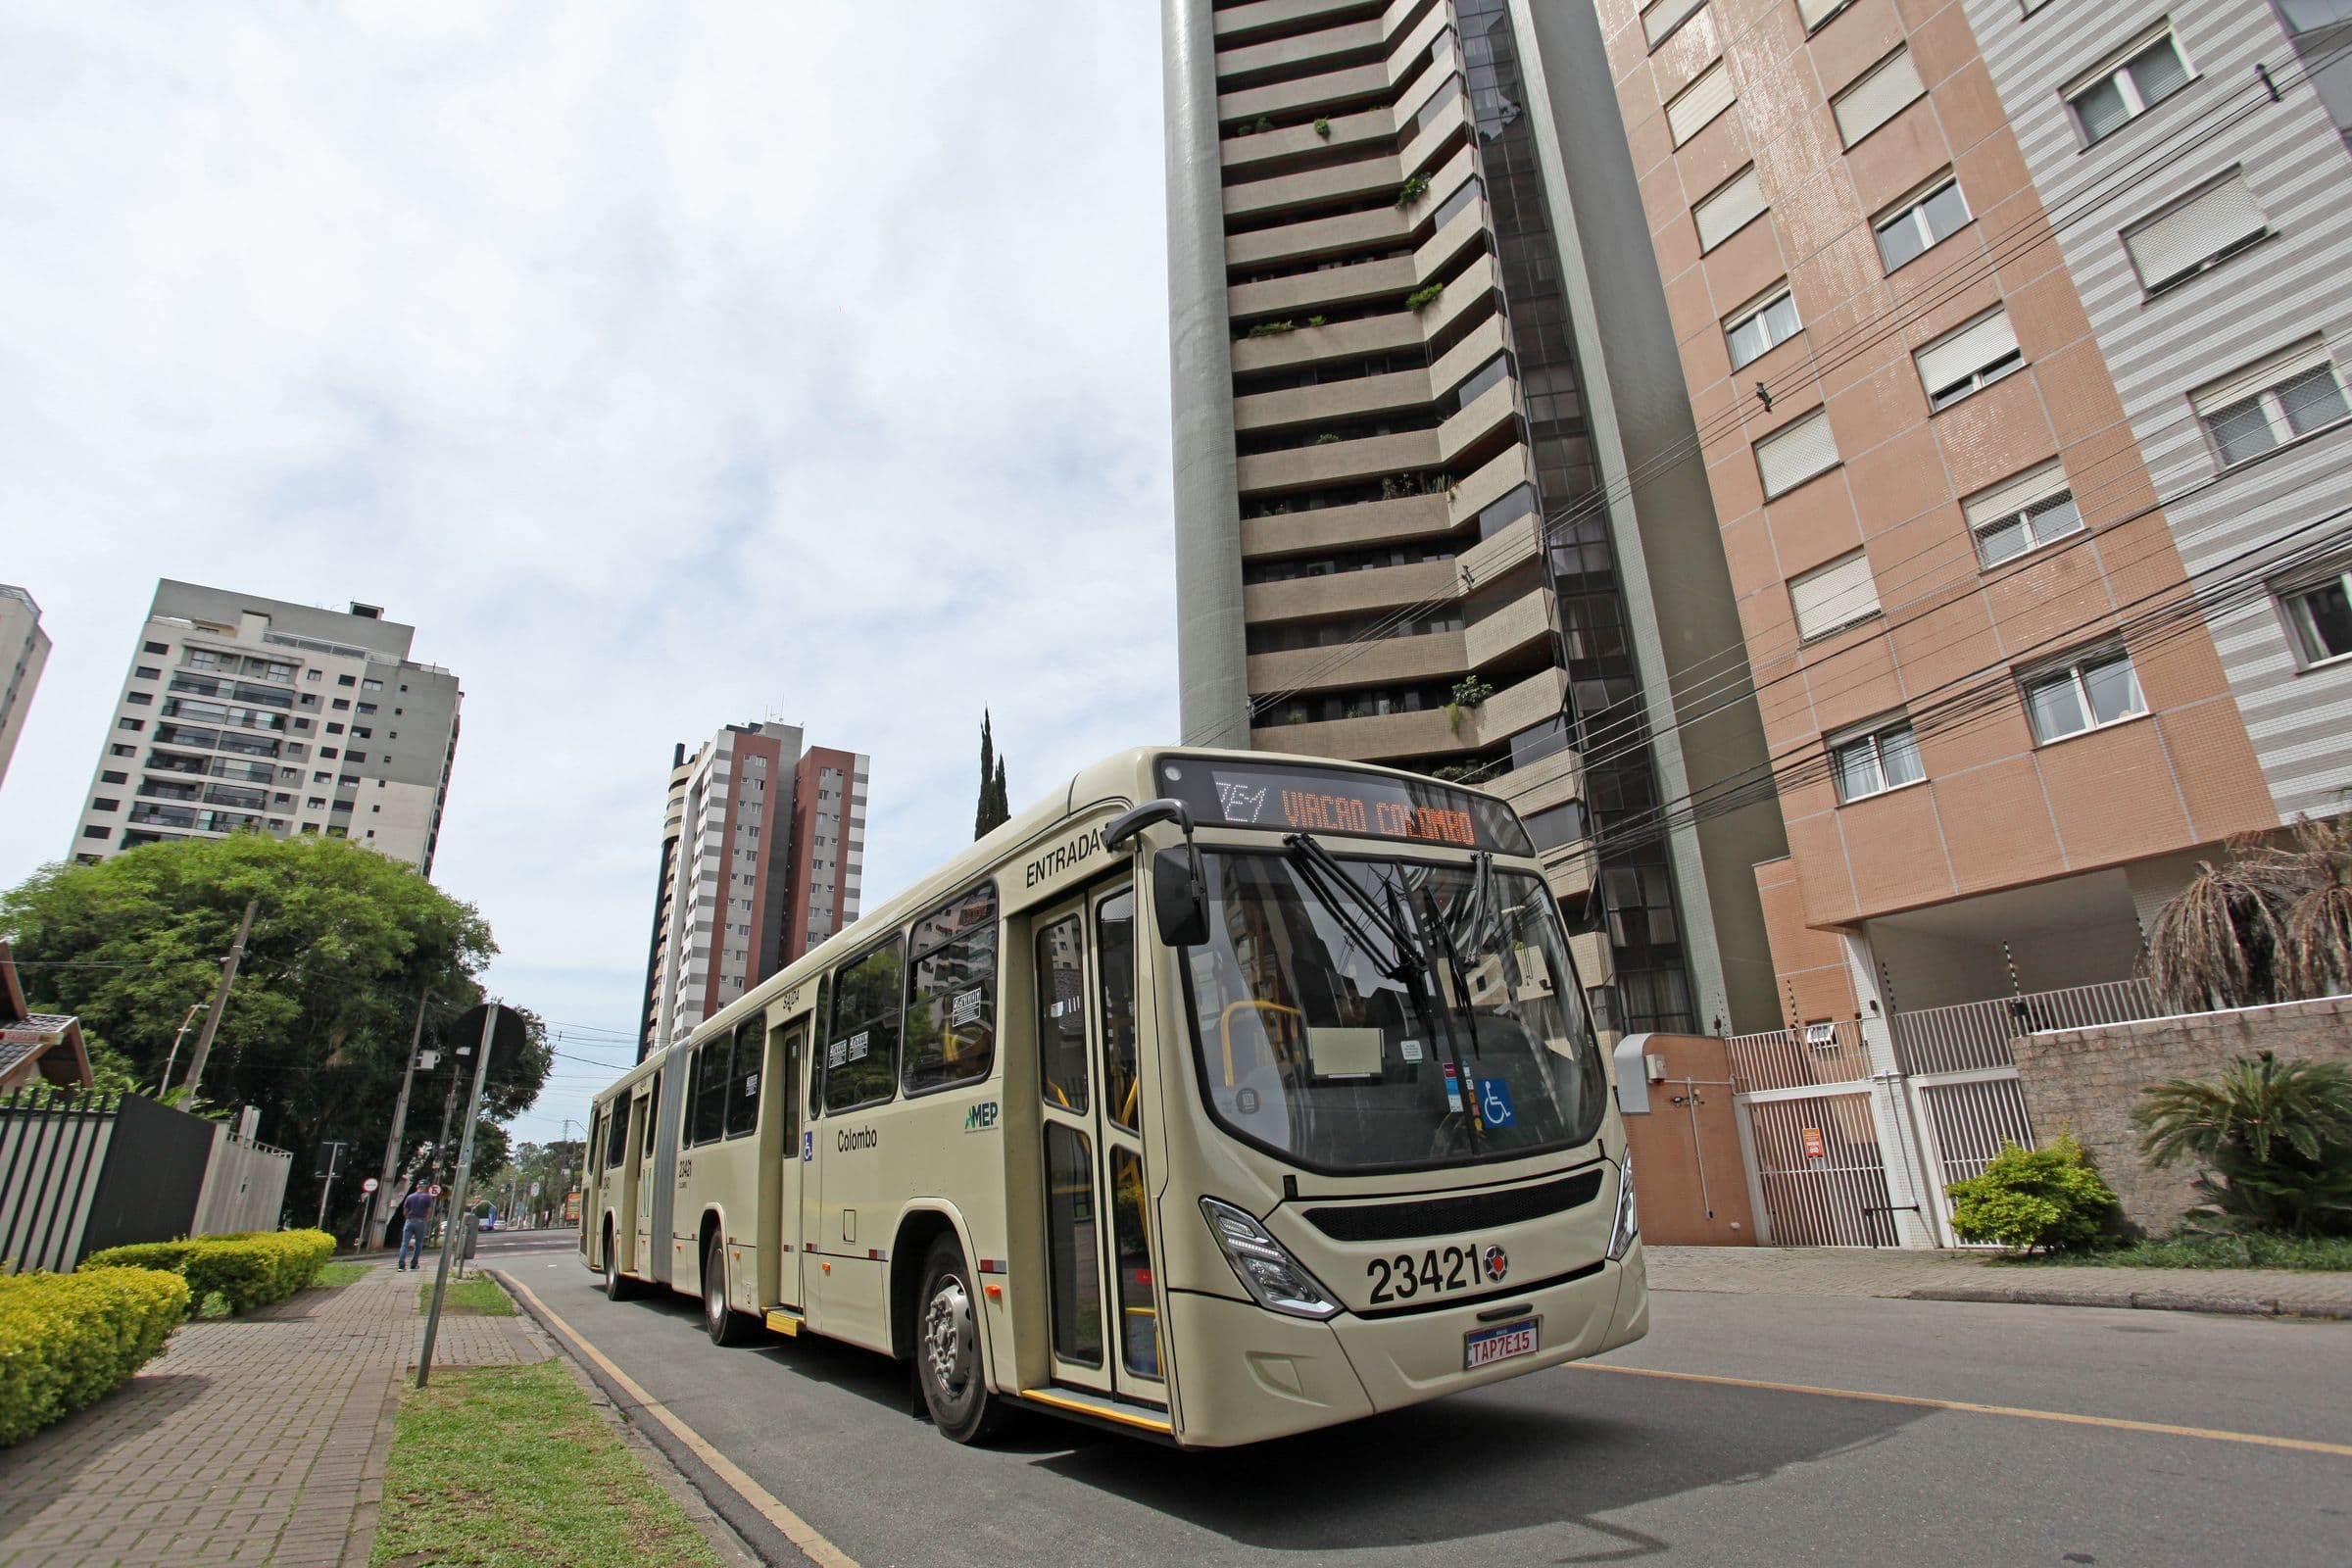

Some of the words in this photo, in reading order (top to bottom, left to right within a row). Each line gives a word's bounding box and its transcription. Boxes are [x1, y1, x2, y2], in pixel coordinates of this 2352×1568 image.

[1026, 828, 1101, 889] ENTRADA
[964, 1102, 999, 1129] AMEP
[837, 1124, 877, 1152] Colombo
[1366, 1243, 1482, 1305] 23421
[1473, 1331, 1530, 1363] TAP7E15
